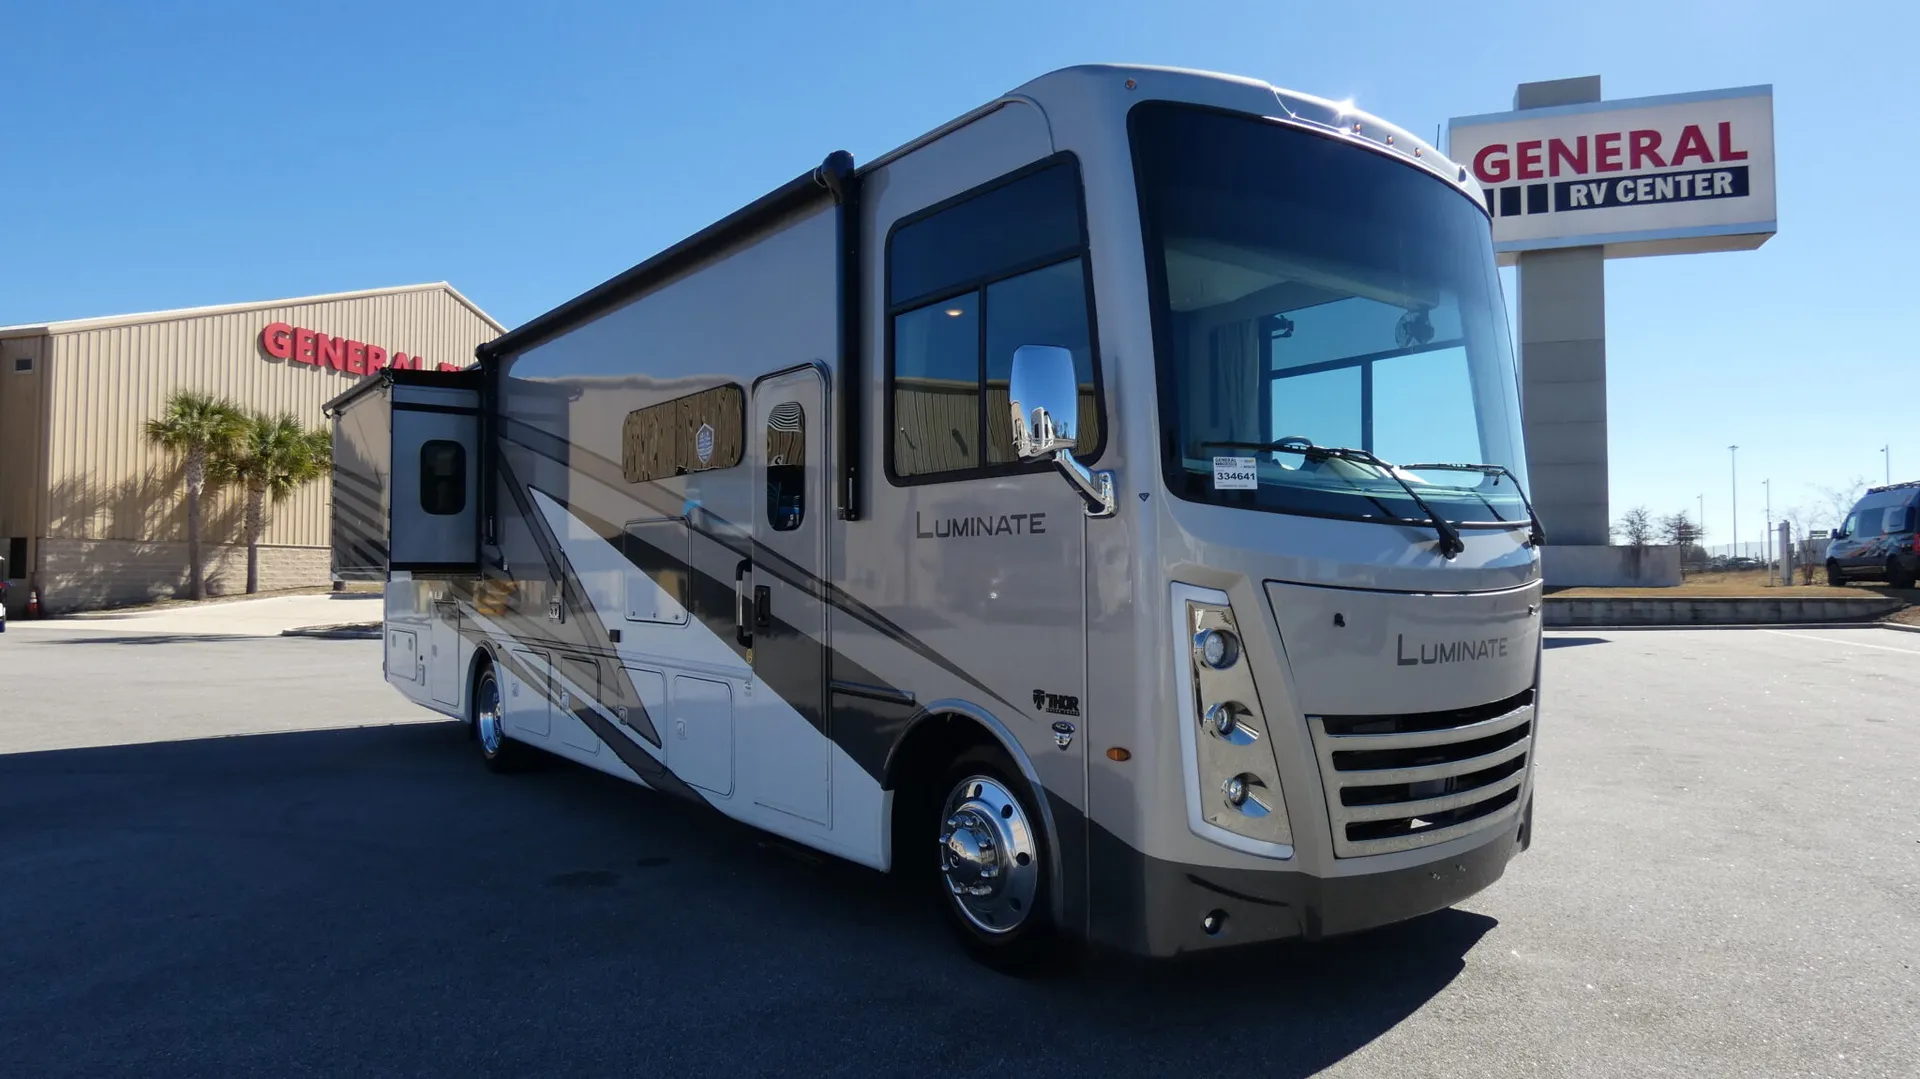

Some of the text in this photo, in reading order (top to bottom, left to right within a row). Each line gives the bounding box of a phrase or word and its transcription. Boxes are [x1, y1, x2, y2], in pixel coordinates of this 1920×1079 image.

[1472, 121, 1748, 184] GENERAL
[1570, 171, 1733, 207] RV CENTER
[1217, 472, 1256, 481] 334641
[916, 511, 1046, 539] LUMINATE
[1397, 633, 1508, 666] LUMINATE
[1045, 693, 1079, 711] THOR
